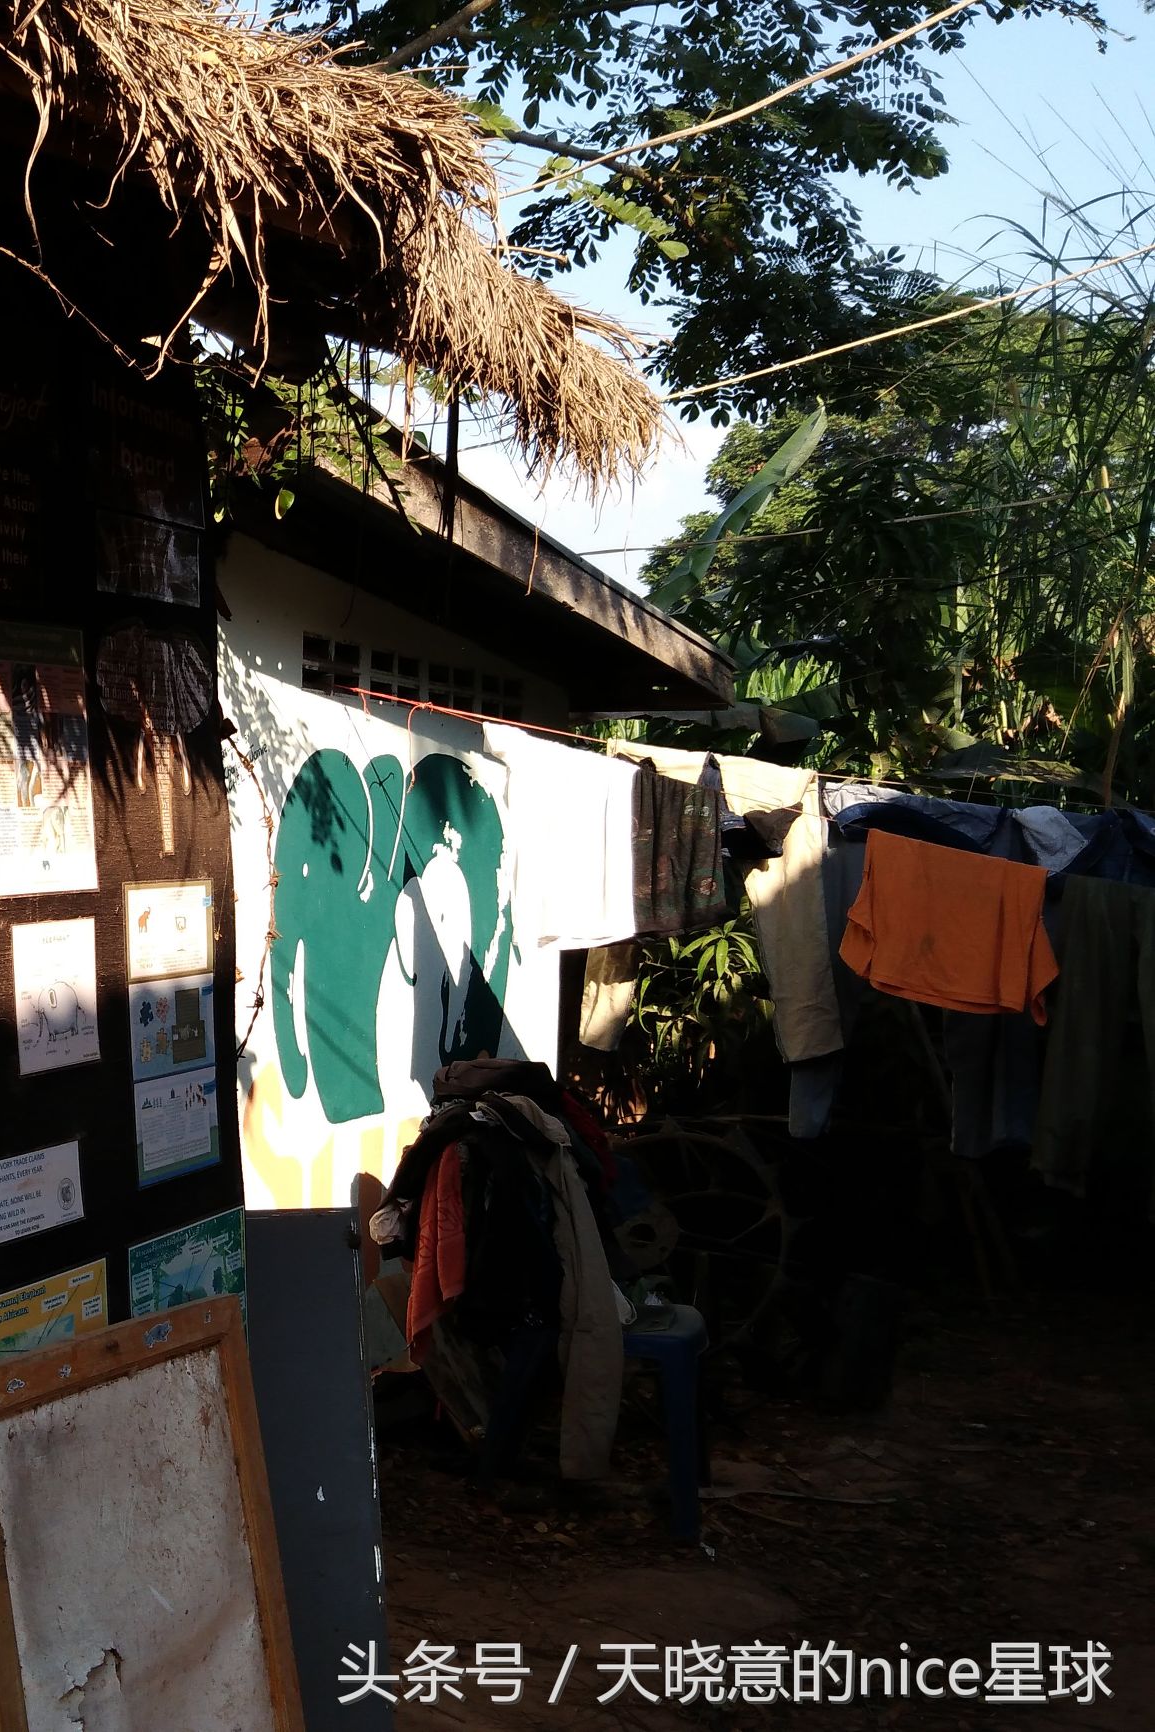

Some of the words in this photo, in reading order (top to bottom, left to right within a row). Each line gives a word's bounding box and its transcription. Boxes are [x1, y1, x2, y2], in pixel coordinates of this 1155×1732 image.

[13, 465, 30, 485] the
[3, 496, 38, 512] Asian
[2, 548, 28, 567] their
[13, 1156, 28, 1165] TRADE
[28, 1153, 45, 1163] CLAIMS
